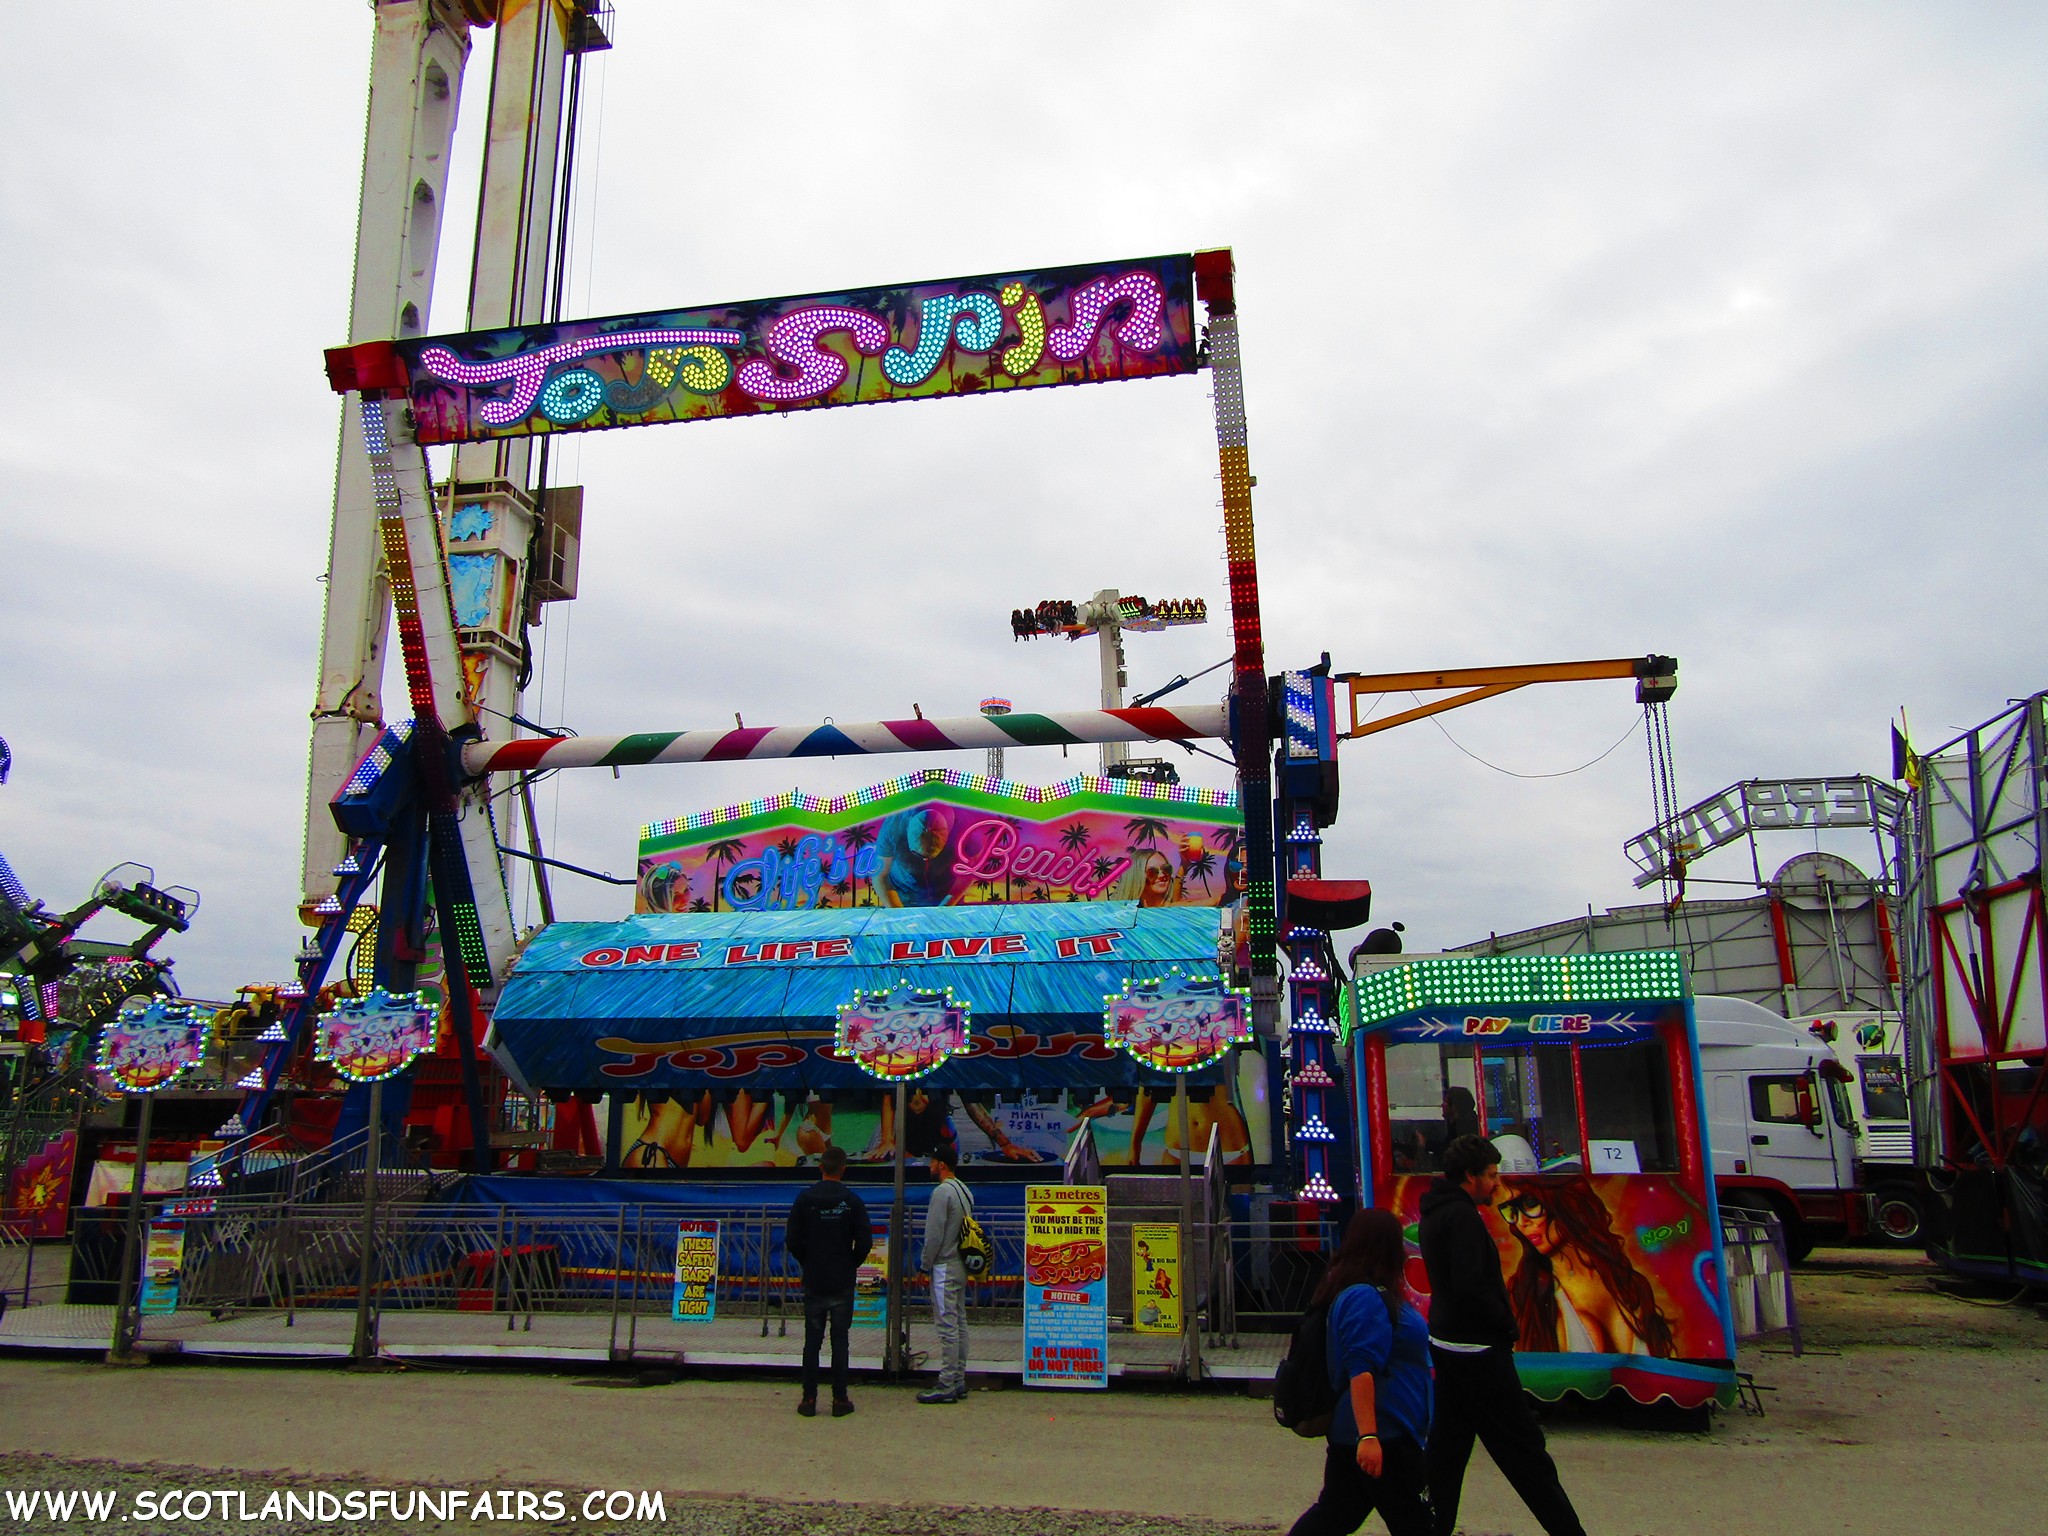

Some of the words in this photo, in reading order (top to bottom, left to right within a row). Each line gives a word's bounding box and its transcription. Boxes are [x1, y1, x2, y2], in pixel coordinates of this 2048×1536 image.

[952, 818, 1133, 899] Beach!
[580, 942, 702, 967] ONE
[725, 937, 852, 966] LIFE
[890, 934, 1029, 962] LIVE
[1055, 931, 1123, 959] IT
[1463, 1016, 1511, 1036] PAY
[1528, 1014, 1592, 1034] HERE
[1011, 1111, 1044, 1119] MIAMI
[1009, 1120, 1040, 1130] 7584
[1047, 1122, 1061, 1130] KM
[1603, 1147, 1622, 1161] T2
[1032, 1189, 1051, 1200] 1.3
[1056, 1189, 1100, 1200] metres
[174, 1199, 214, 1215] EXIT
[1030, 1215, 1046, 1224] YOU
[1048, 1216, 1070, 1224] MUST
[1073, 1216, 1082, 1224] BE
[1085, 1216, 1104, 1224] THIS
[1033, 1226, 1050, 1234] TALL
[1065, 1226, 1083, 1234] RIDE
[1085, 1226, 1100, 1234] THE
[1642, 1226, 1672, 1245] NO
[1677, 1221, 1688, 1234] 1
[683, 1237, 713, 1251] THESE
[678, 1252, 716, 1267] SAFETY
[682, 1268, 710, 1283] BARS
[684, 1285, 706, 1298] ARE
[1050, 1291, 1081, 1302] NOTICE
[679, 1299, 709, 1315] TIGHT
[1032, 1346, 1042, 1358] IF
[1045, 1347, 1057, 1359] IN
[1060, 1347, 1099, 1360] DOUBT
[1028, 1359, 1044, 1371] DO
[1047, 1359, 1070, 1372] NOT
[1073, 1360, 1104, 1373] RIDE!
